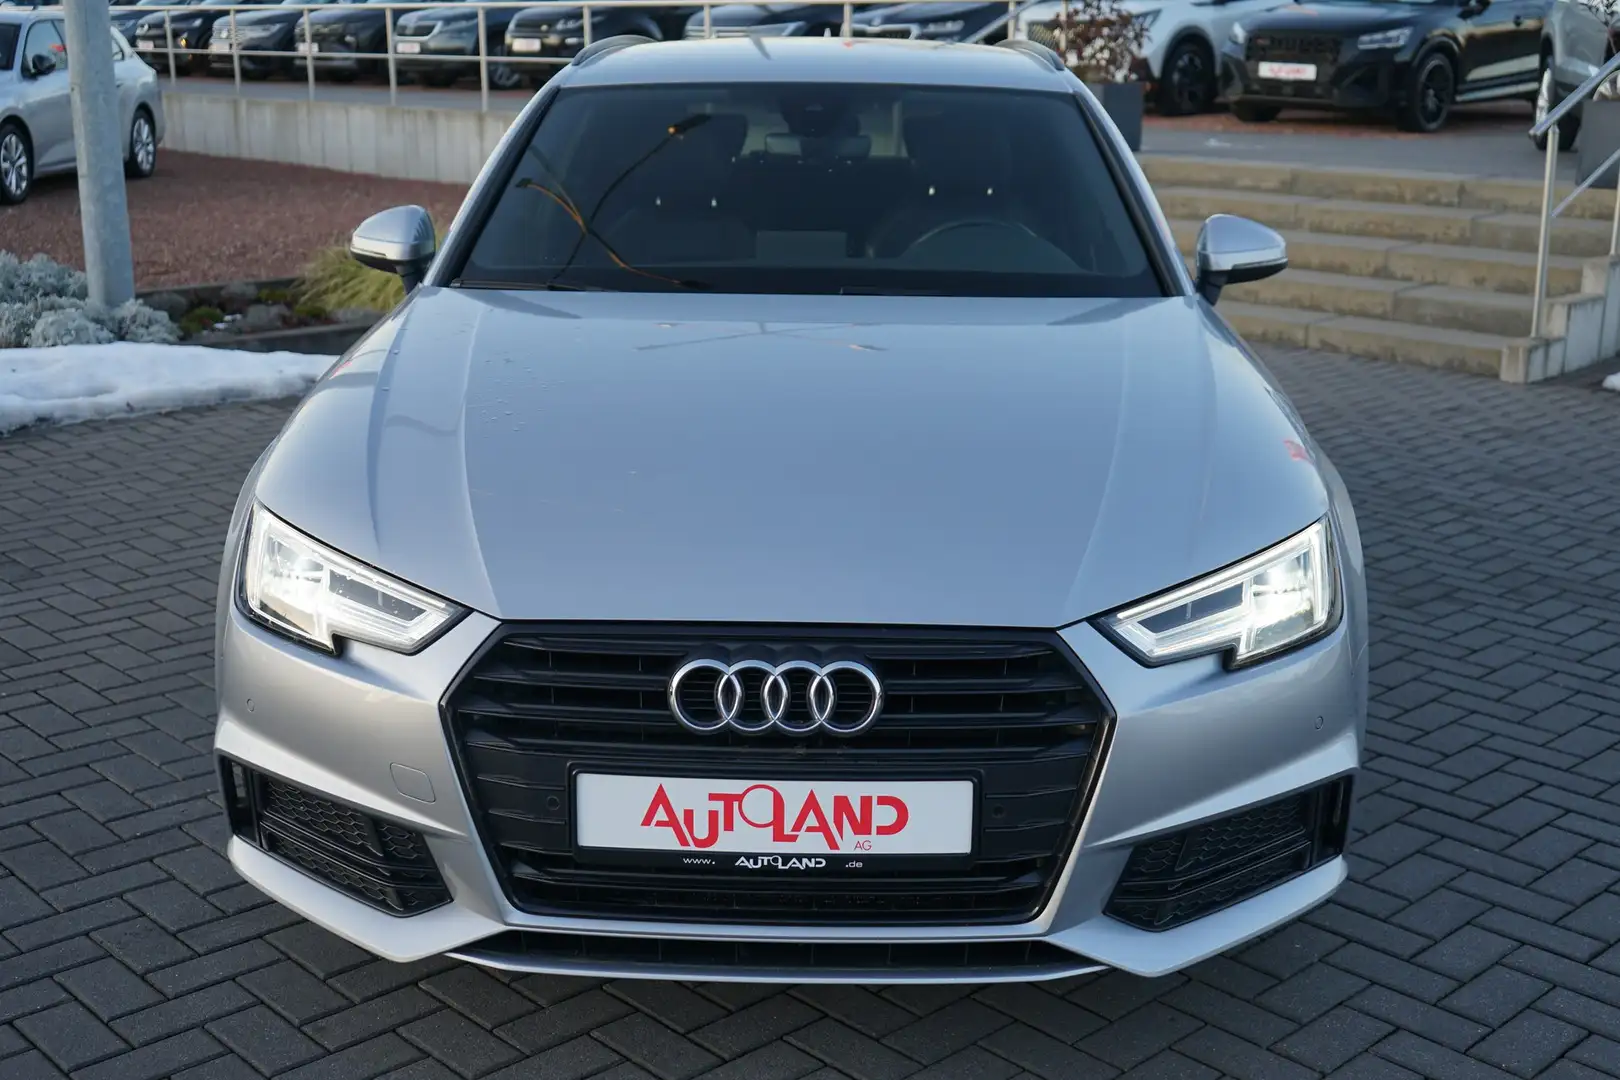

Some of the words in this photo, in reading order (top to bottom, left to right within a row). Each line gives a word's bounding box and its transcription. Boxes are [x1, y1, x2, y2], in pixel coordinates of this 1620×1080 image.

[640, 783, 910, 851] AUTOLAND
[854, 840, 873, 851] AG
[682, 857, 716, 865] www.
[734, 855, 827, 870] AUTOLAND
[845, 860, 863, 868] .de
